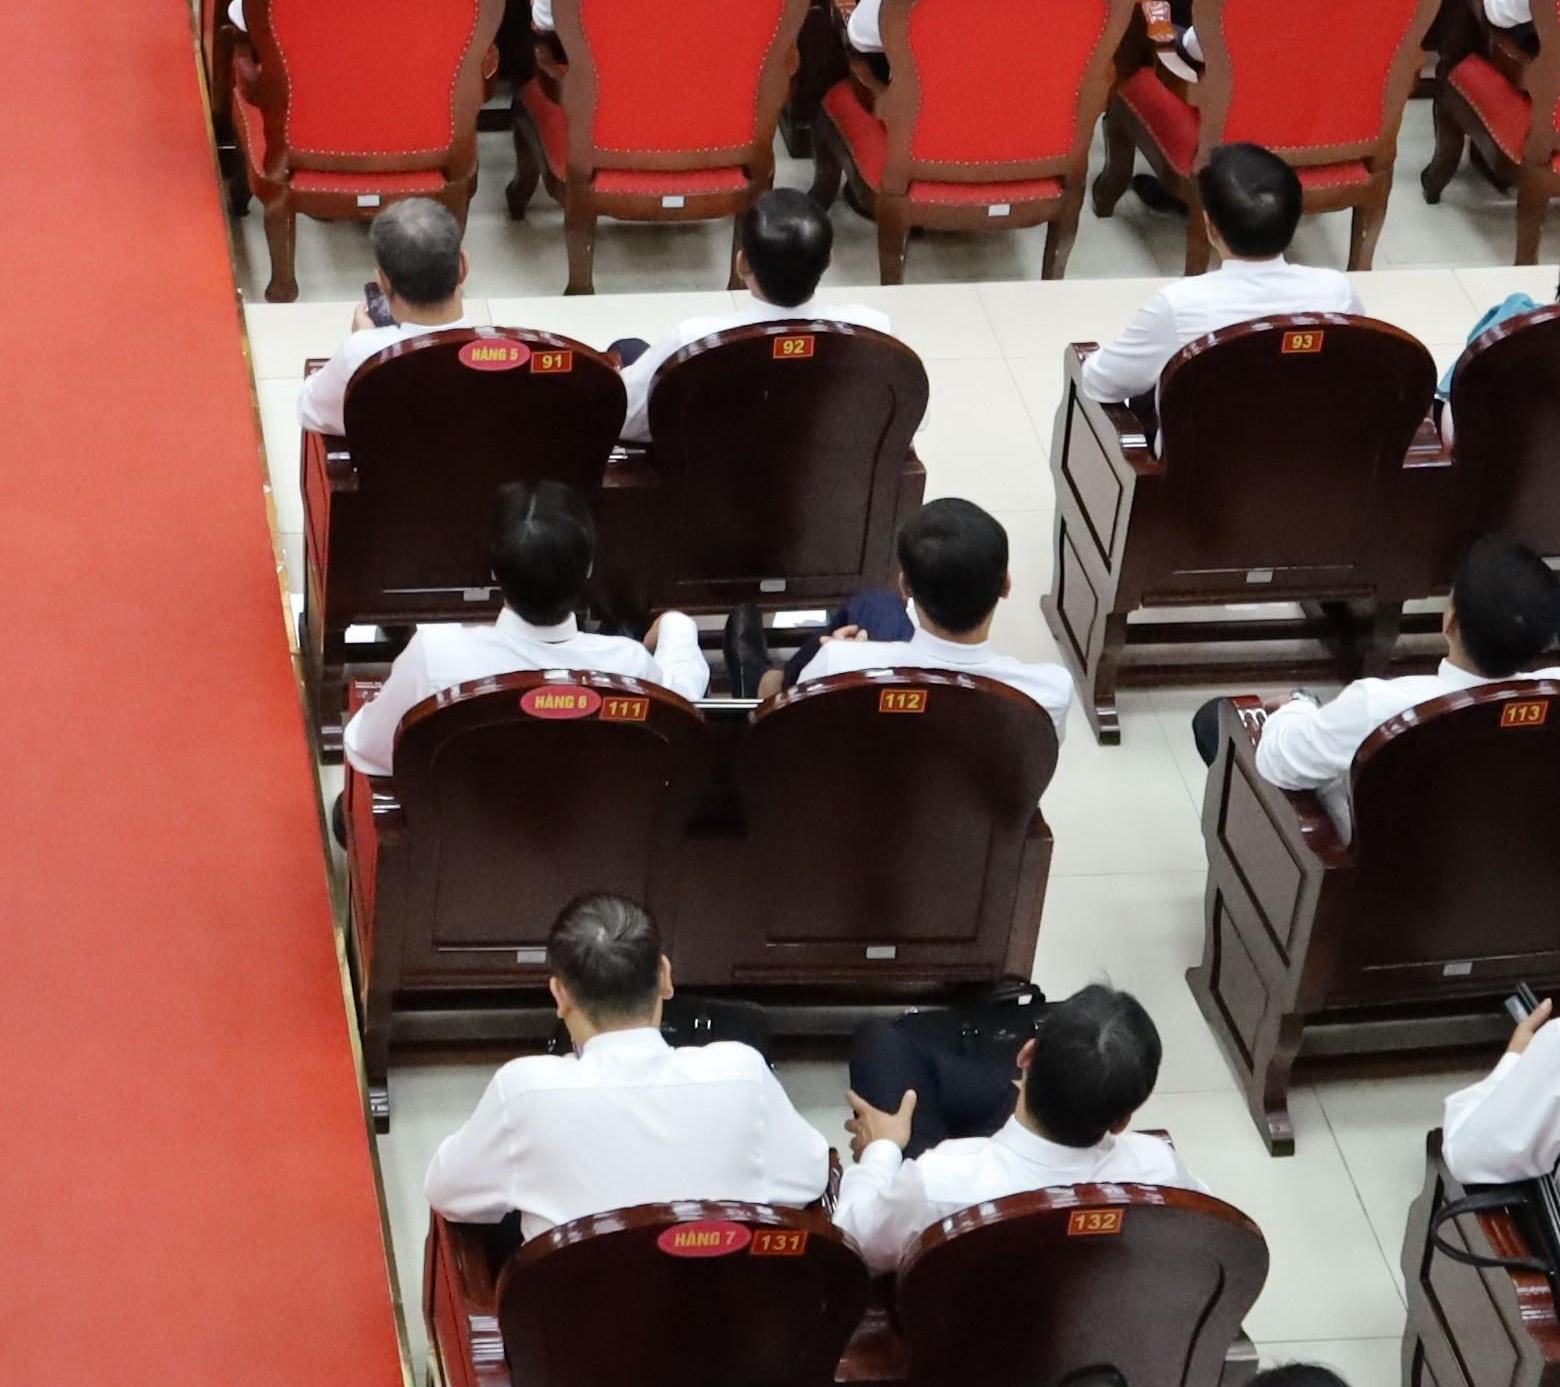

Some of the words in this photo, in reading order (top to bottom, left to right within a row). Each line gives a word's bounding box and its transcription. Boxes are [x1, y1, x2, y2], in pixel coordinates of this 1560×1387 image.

[471, 346, 507, 362] HÀNG
[509, 347, 519, 362] 5
[782, 338, 806, 356] 92
[541, 355, 563, 370] 91
[534, 693, 575, 709] HÀNG
[608, 701, 641, 717] 111
[1507, 705, 1541, 723] 113
[674, 1230, 721, 1247] HÀNG
[725, 1231, 737, 1246] 7
[761, 1234, 800, 1251] 131
